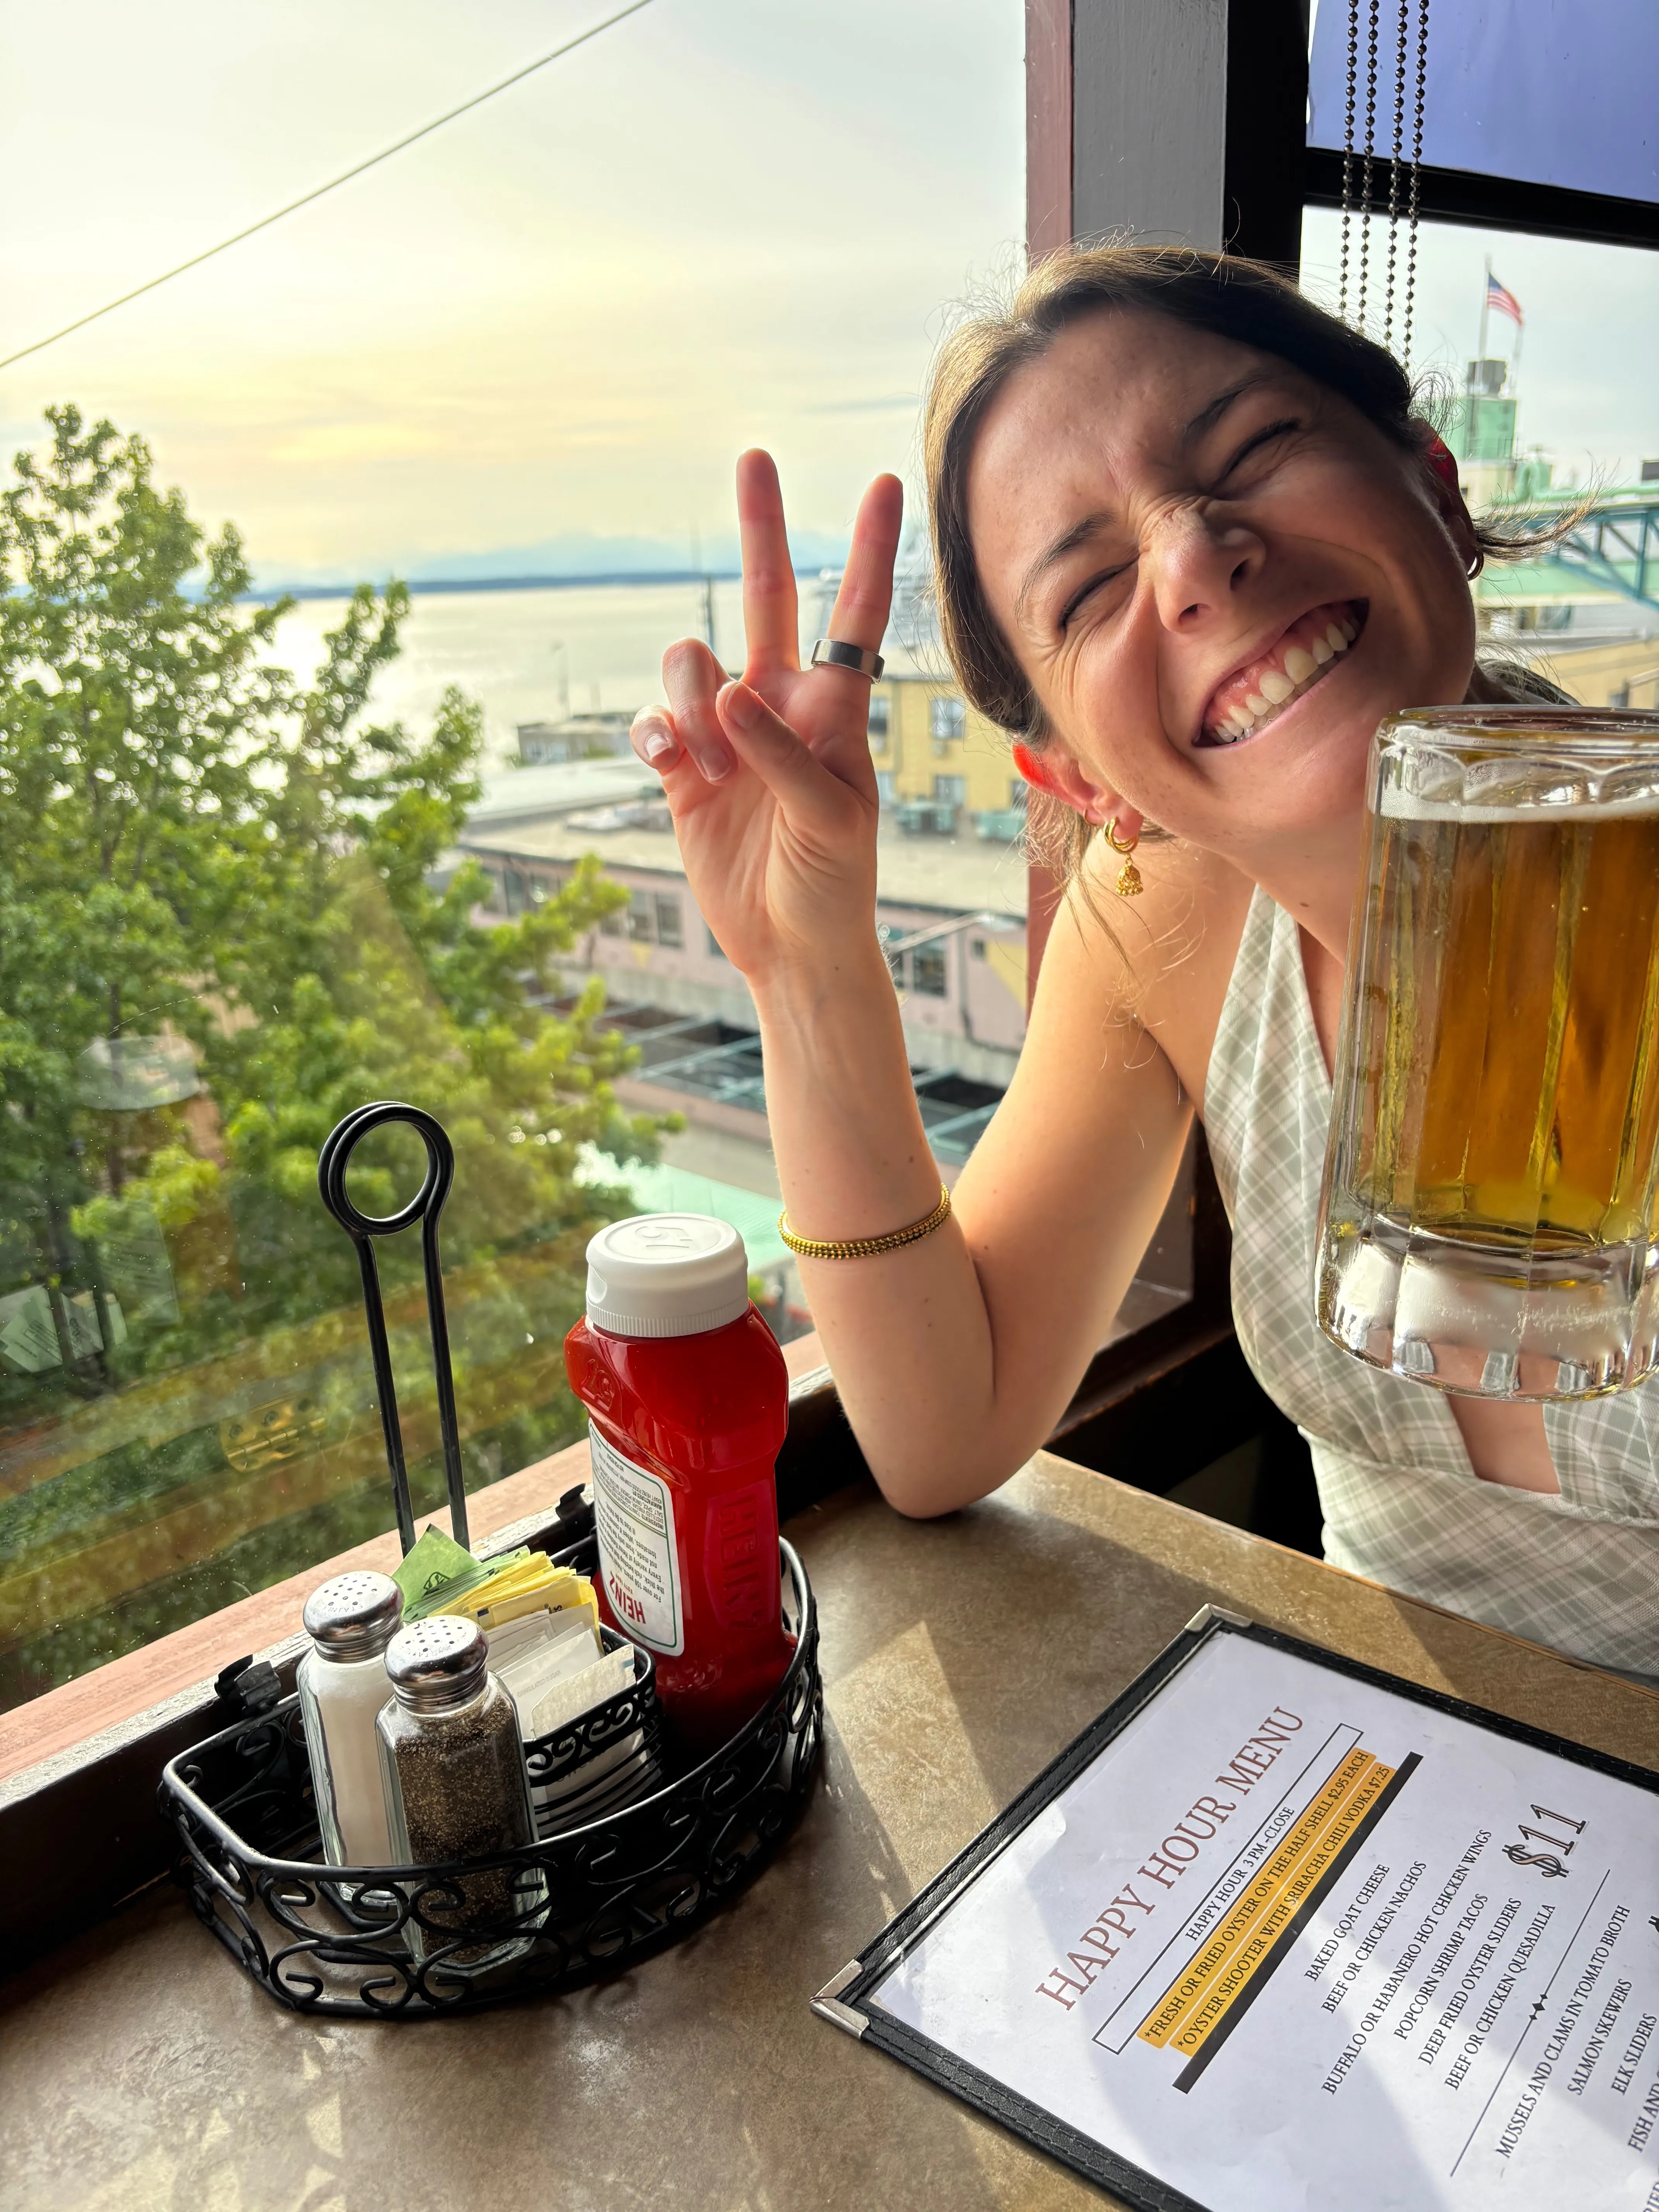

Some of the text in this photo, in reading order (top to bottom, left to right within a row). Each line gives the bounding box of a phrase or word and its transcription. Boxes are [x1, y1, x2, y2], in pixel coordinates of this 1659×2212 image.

[610, 1570, 646, 1624] HEINZ
[656, 1584, 665, 1595] the
[719, 1494, 764, 1630] HEINZ
[517, 1670, 561, 1697] GRANULATED SUGAR
[1035, 1706, 1302, 2011] HAPPY HOUR MENU
[1181, 1978, 1202, 1996] OR
[1194, 1942, 1226, 1978] FRIED
[1222, 1898, 1261, 1941] OYSTER
[1255, 1877, 1274, 1896] ON
[1267, 1856, 1291, 1878] THE
[1284, 1828, 1310, 1857] HALF
[1305, 1800, 1334, 1829] SHELL
[1328, 1778, 1349, 1800] $2.95
[1342, 1751, 1369, 1779] EACH
[1185, 1900, 1221, 1941] HAPPY
[1215, 1870, 1248, 1903] HOUR
[1247, 1843, 1267, 1860] PM
[1264, 1807, 1295, 1843] -CLOSE
[1218, 1939, 1268, 1996] SHOOTER
[1259, 1903, 1291, 1936] WITH
[1284, 1853, 1329, 1905] SRIRACHA
[1323, 1822, 1350, 1851] CHILI
[1342, 1789, 1376, 1821] VODKA
[1368, 1767, 1389, 1788] $7.25
[1502, 1804, 1586, 1878] $11
[1304, 1864, 1389, 1982] BAKED GOAT CHEESE
[1321, 1861, 1426, 2014] BEEF OR CHICKEN NACHOS
[1321, 1830, 1491, 2095] BUFFALO OR HABANERO HOT CHICKEN WINGS
[1394, 1894, 1487, 2040] POPCORN SHRIMP TACOS
[1418, 1898, 1521, 2065] DEEP FRIED OYSTER SLIDERS
[1444, 1905, 1555, 2090] BEEF OR CHICKEN QUESADILLA
[1496, 1905, 1630, 2158] MUSSELS AND CLAMS IN TOMATO BROTH
[1568, 1978, 1632, 2095] SALMON SKEWERS
[1611, 2013, 1657, 2095] ELK SLIDERS
[1628, 2116, 1653, 2152] FISH
